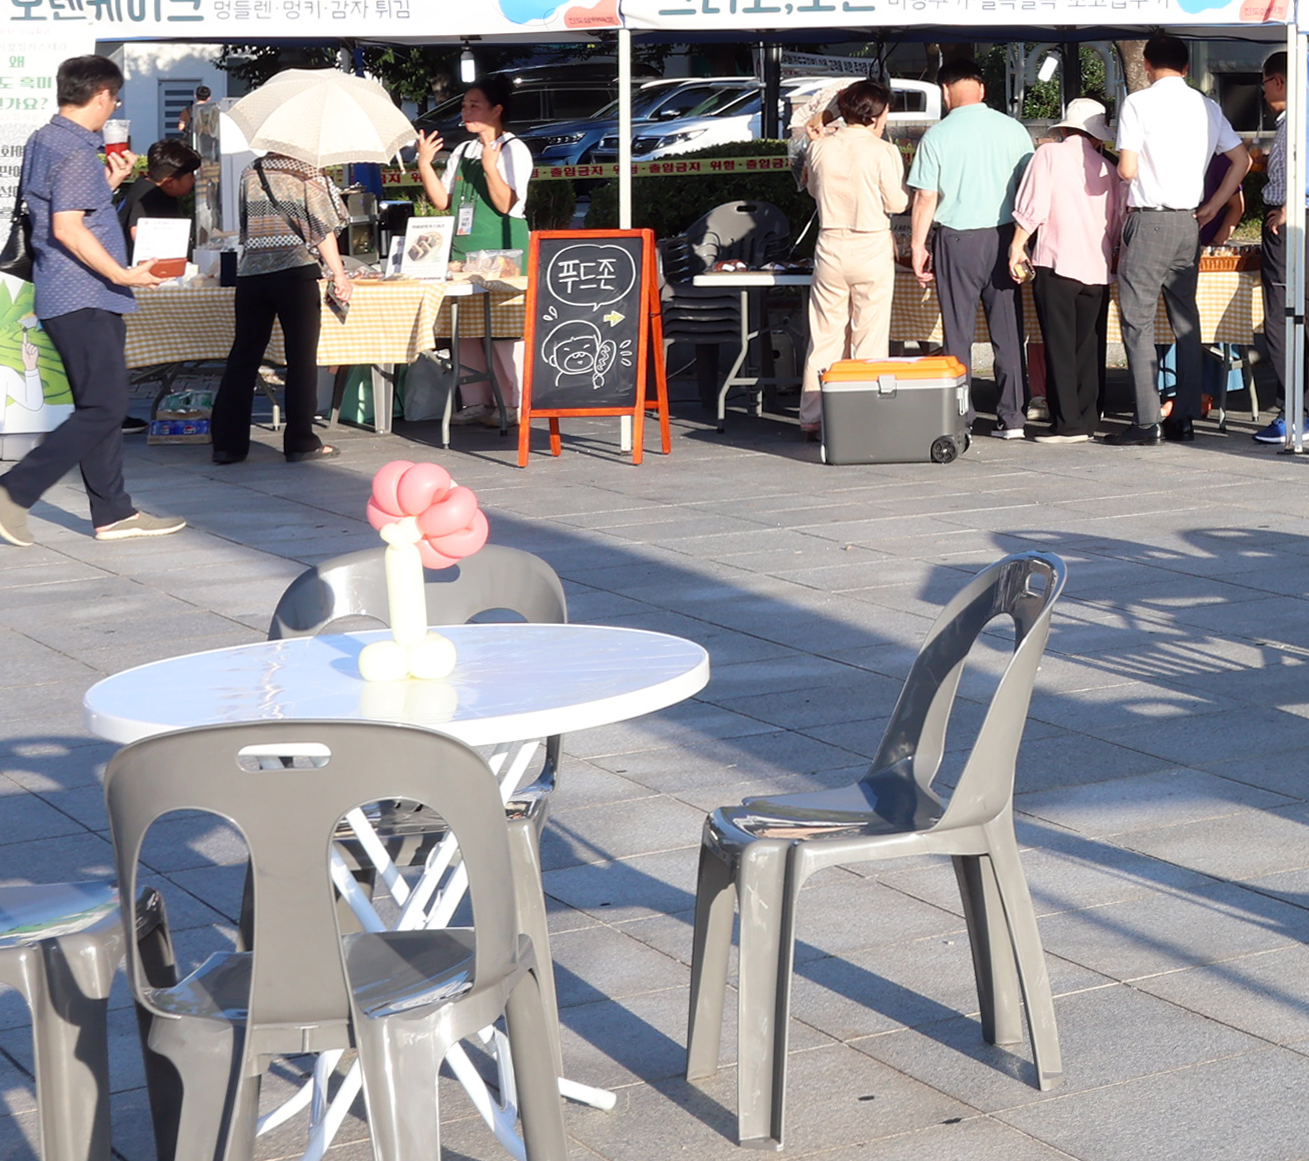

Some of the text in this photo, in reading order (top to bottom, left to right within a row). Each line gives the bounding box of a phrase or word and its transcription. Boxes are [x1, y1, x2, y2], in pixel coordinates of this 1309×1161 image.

[9, 55, 25, 69] 왜
[19, 75, 52, 90] 흑미
[557, 257, 617, 294] 푸드존
